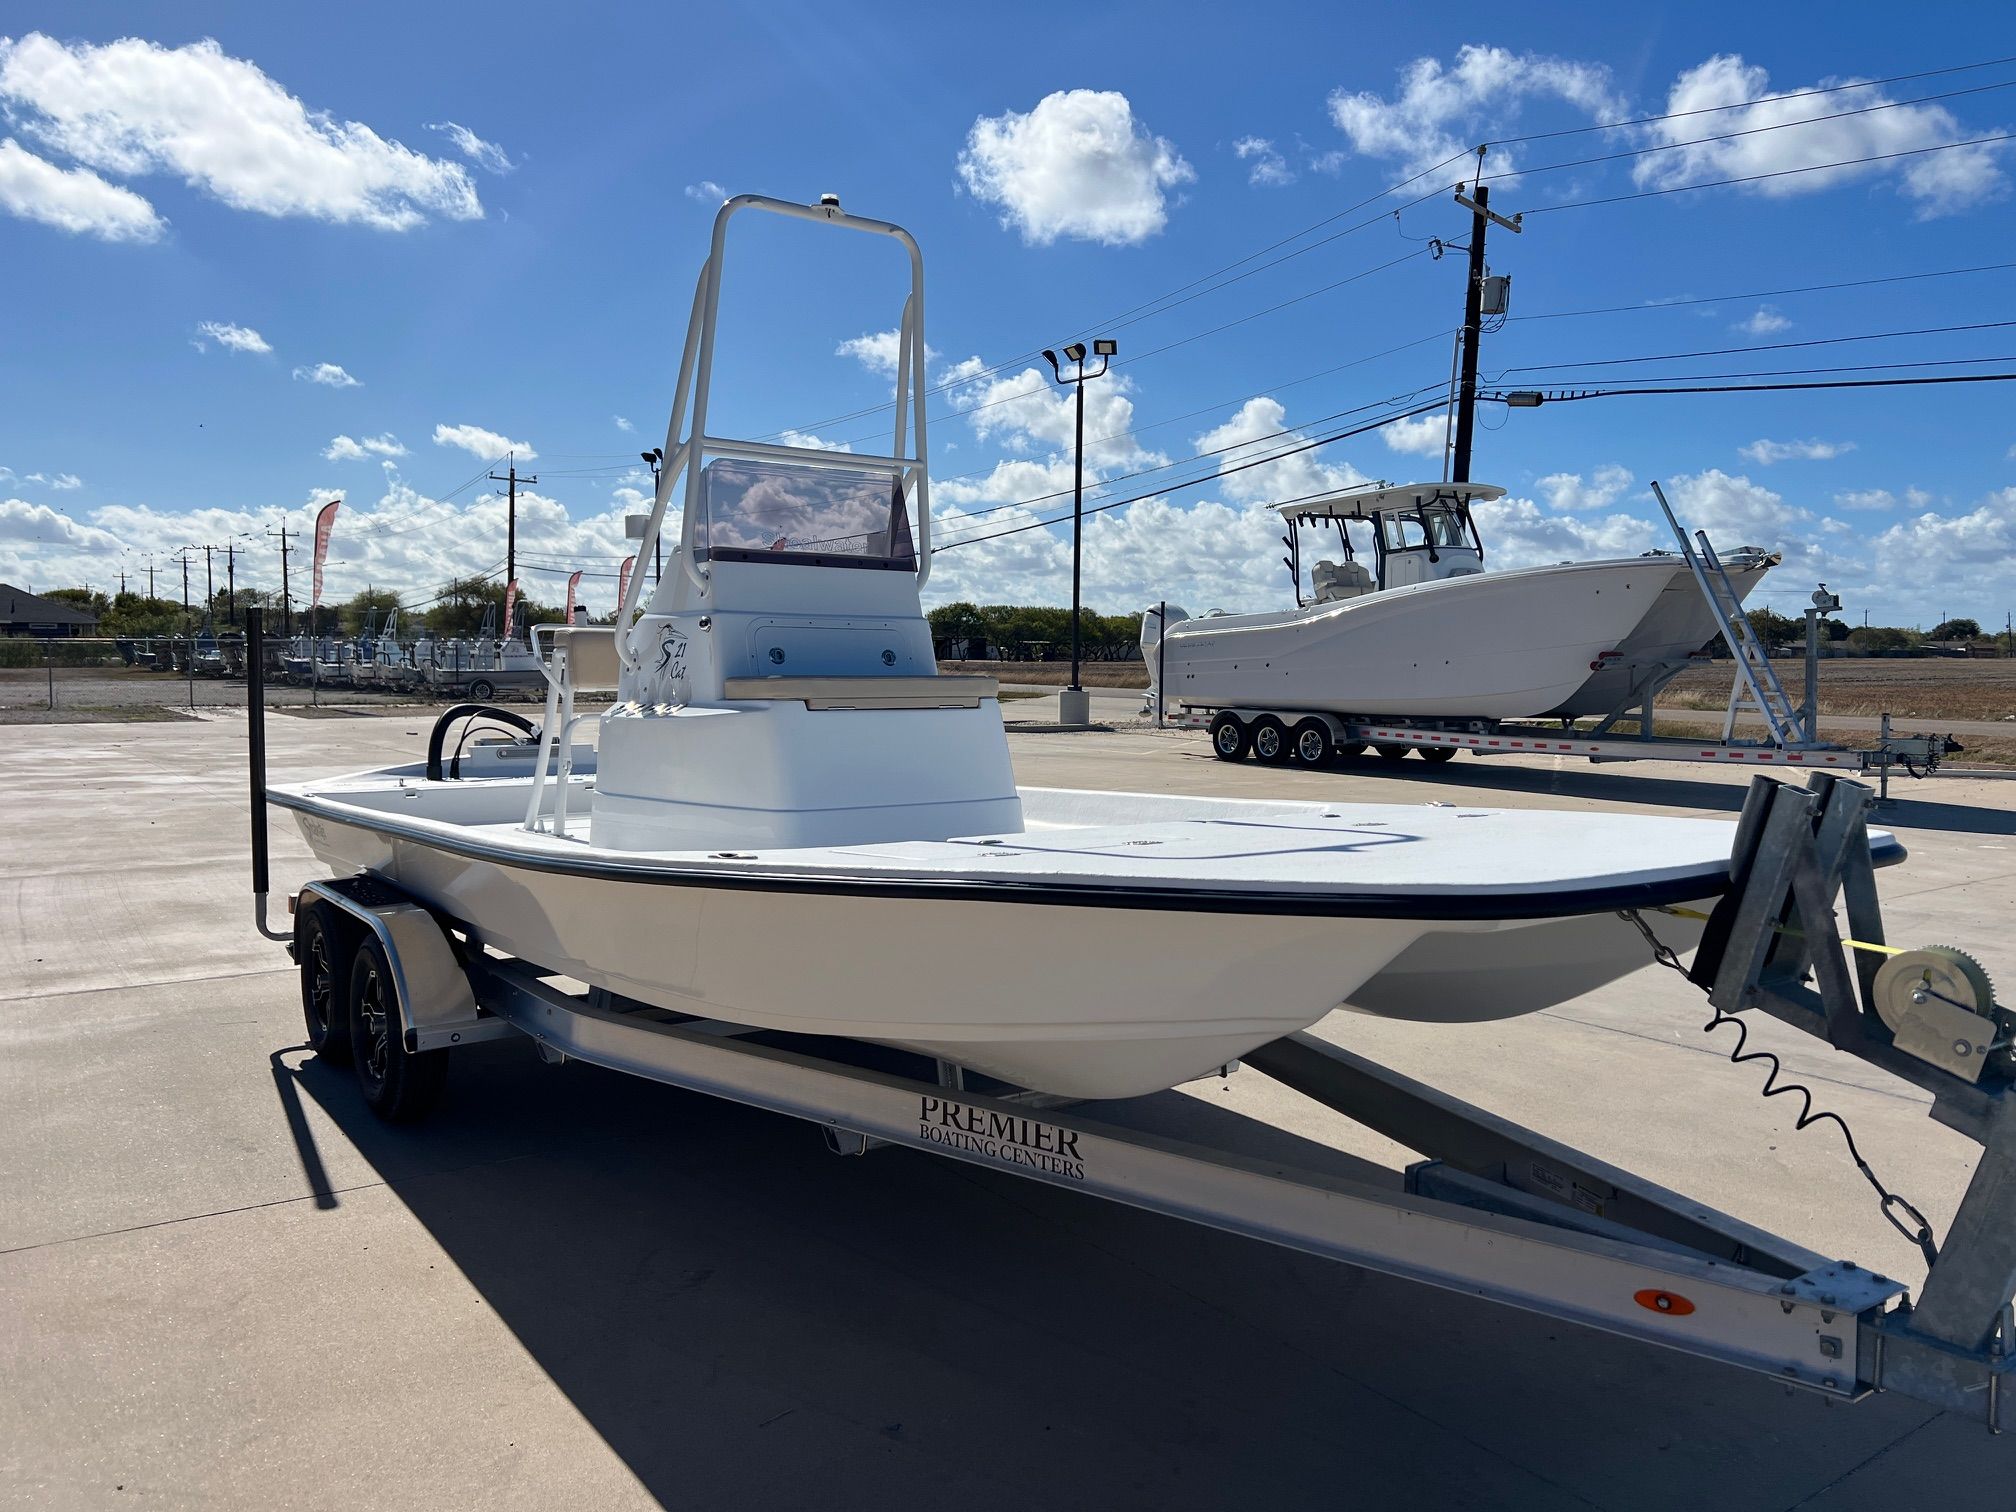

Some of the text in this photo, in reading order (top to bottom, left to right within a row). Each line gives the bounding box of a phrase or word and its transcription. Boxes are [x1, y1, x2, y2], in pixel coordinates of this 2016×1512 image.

[761, 528, 869, 554] Soalwater
[670, 661, 687, 680] Cat
[919, 1096, 1084, 1161] PREMIER
[919, 1123, 1085, 1180] BOATING CENTERS
